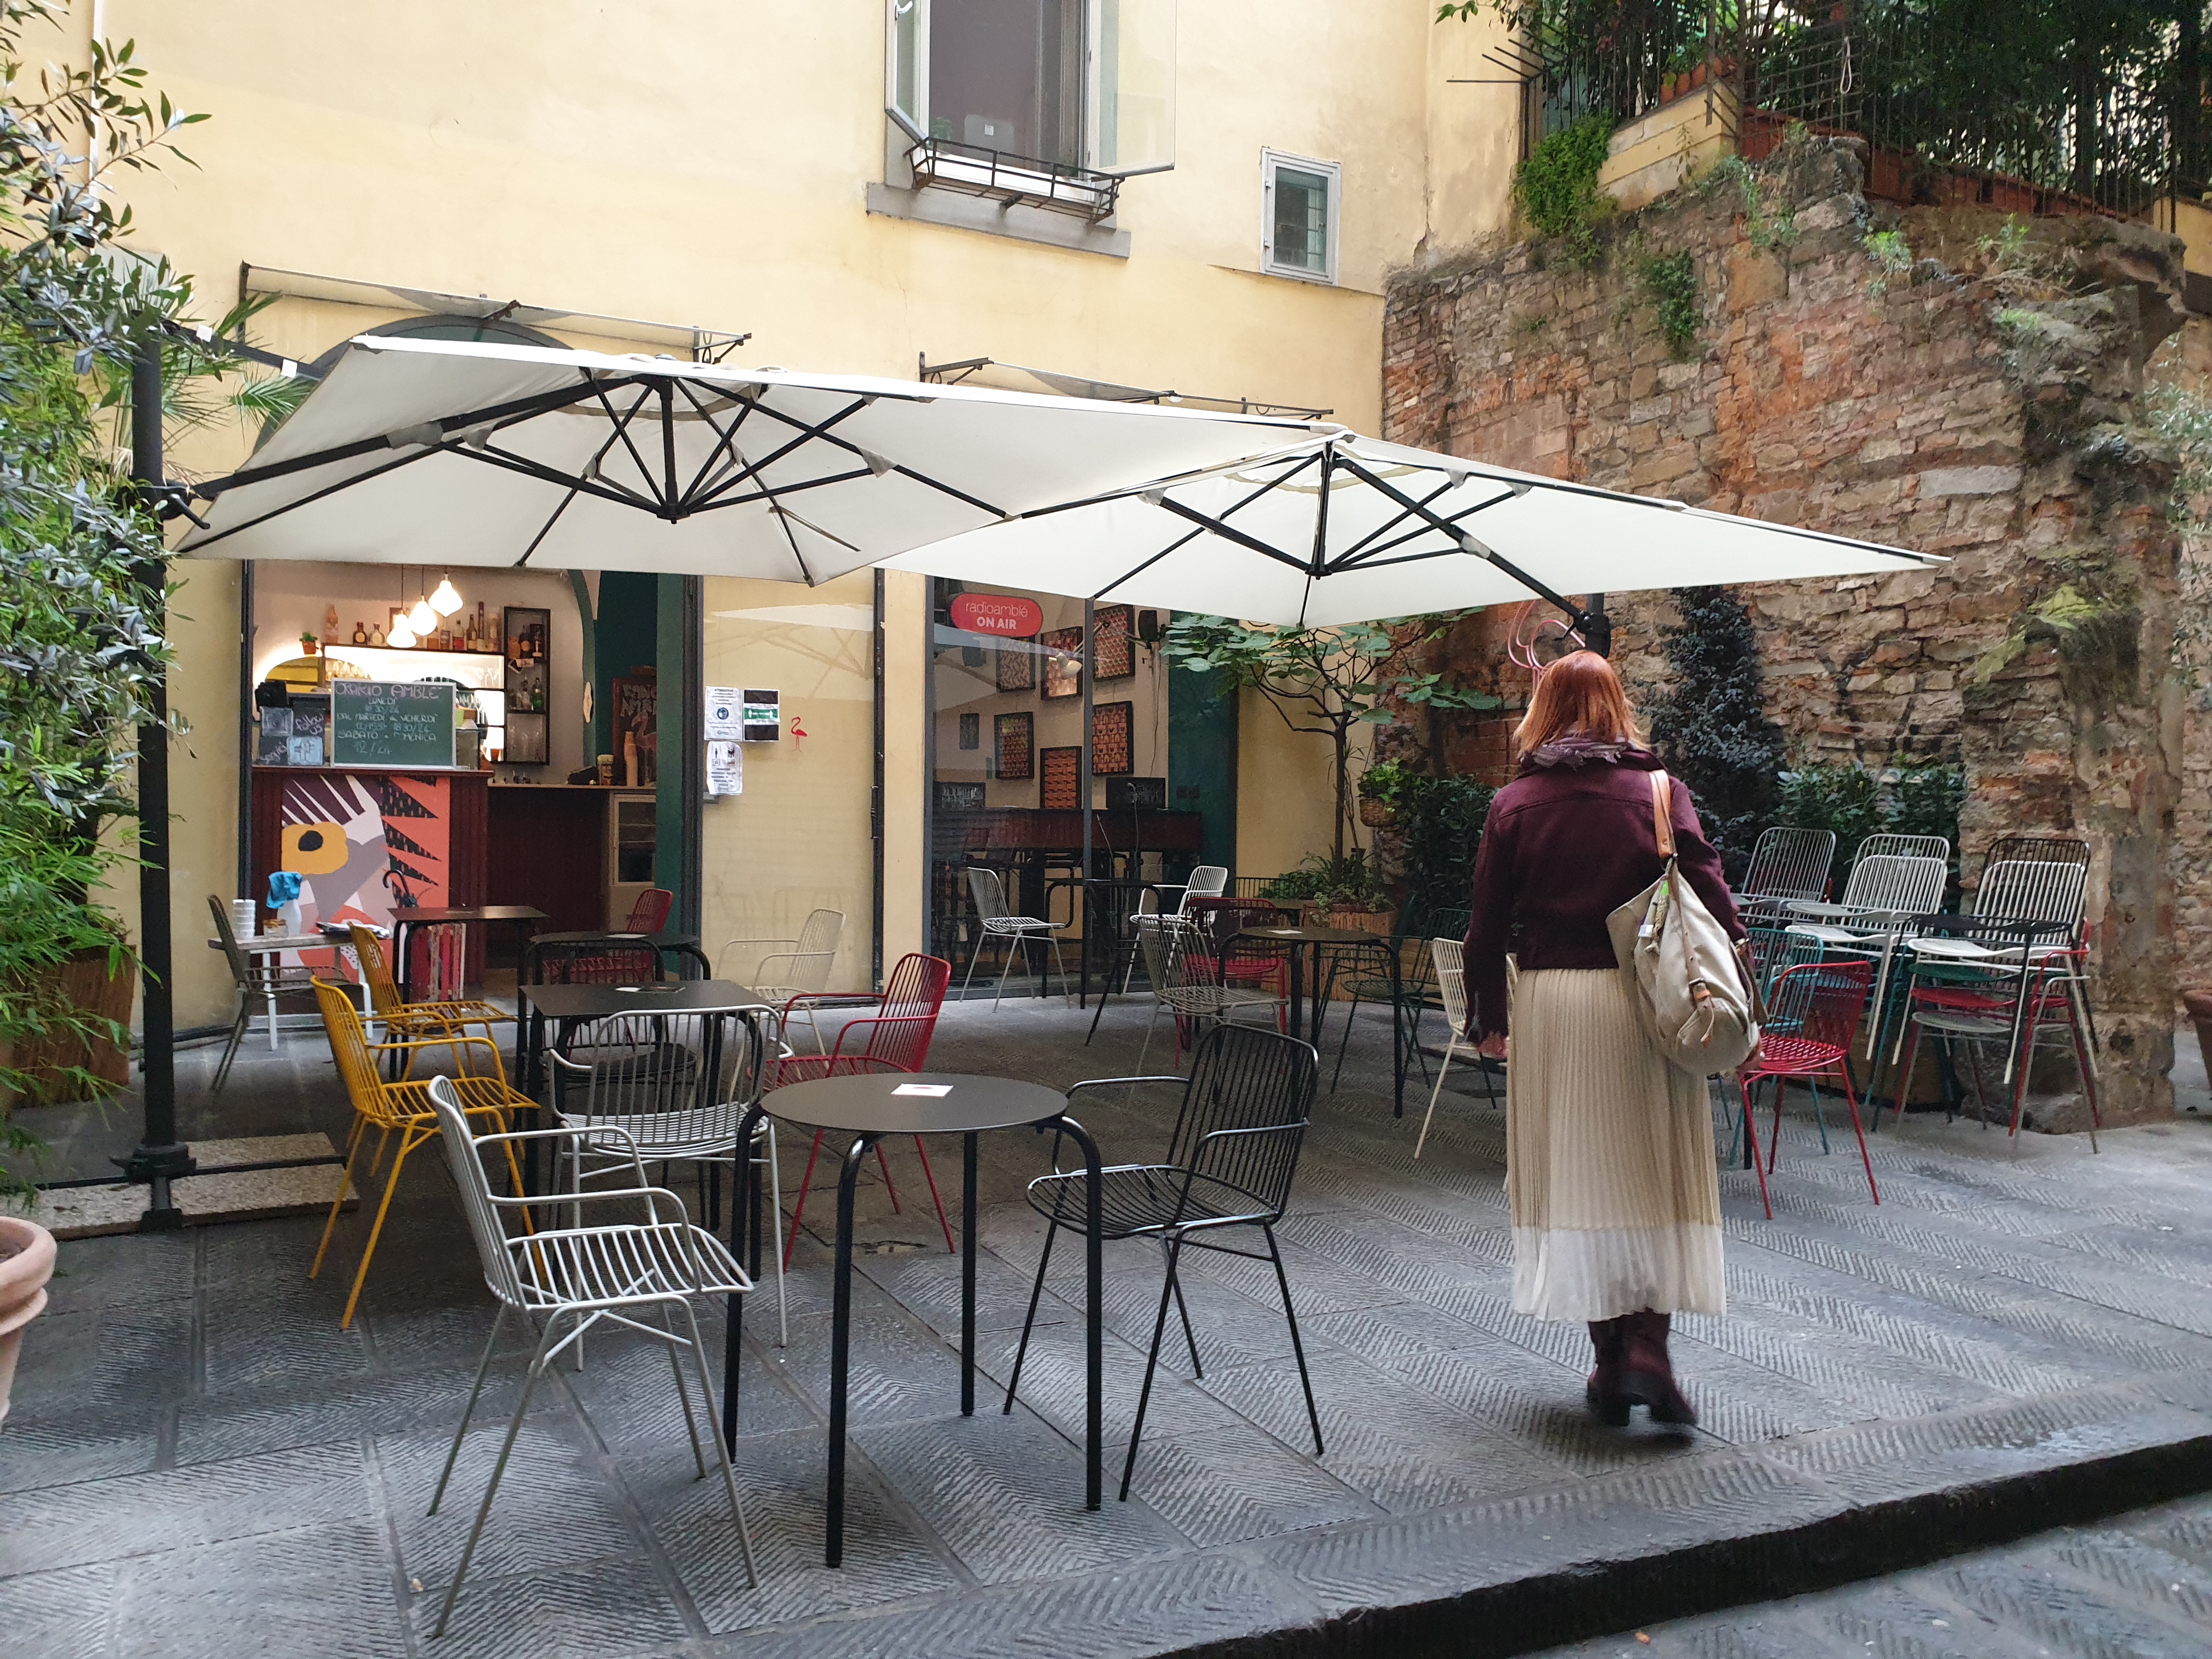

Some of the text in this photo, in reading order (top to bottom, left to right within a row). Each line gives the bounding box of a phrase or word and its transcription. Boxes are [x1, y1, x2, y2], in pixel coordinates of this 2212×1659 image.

[966, 601, 1028, 617] radioamblé
[977, 616, 1017, 629] ON AIR
[335, 683, 382, 697] ORARIO
[337, 731, 379, 739] SABATO
